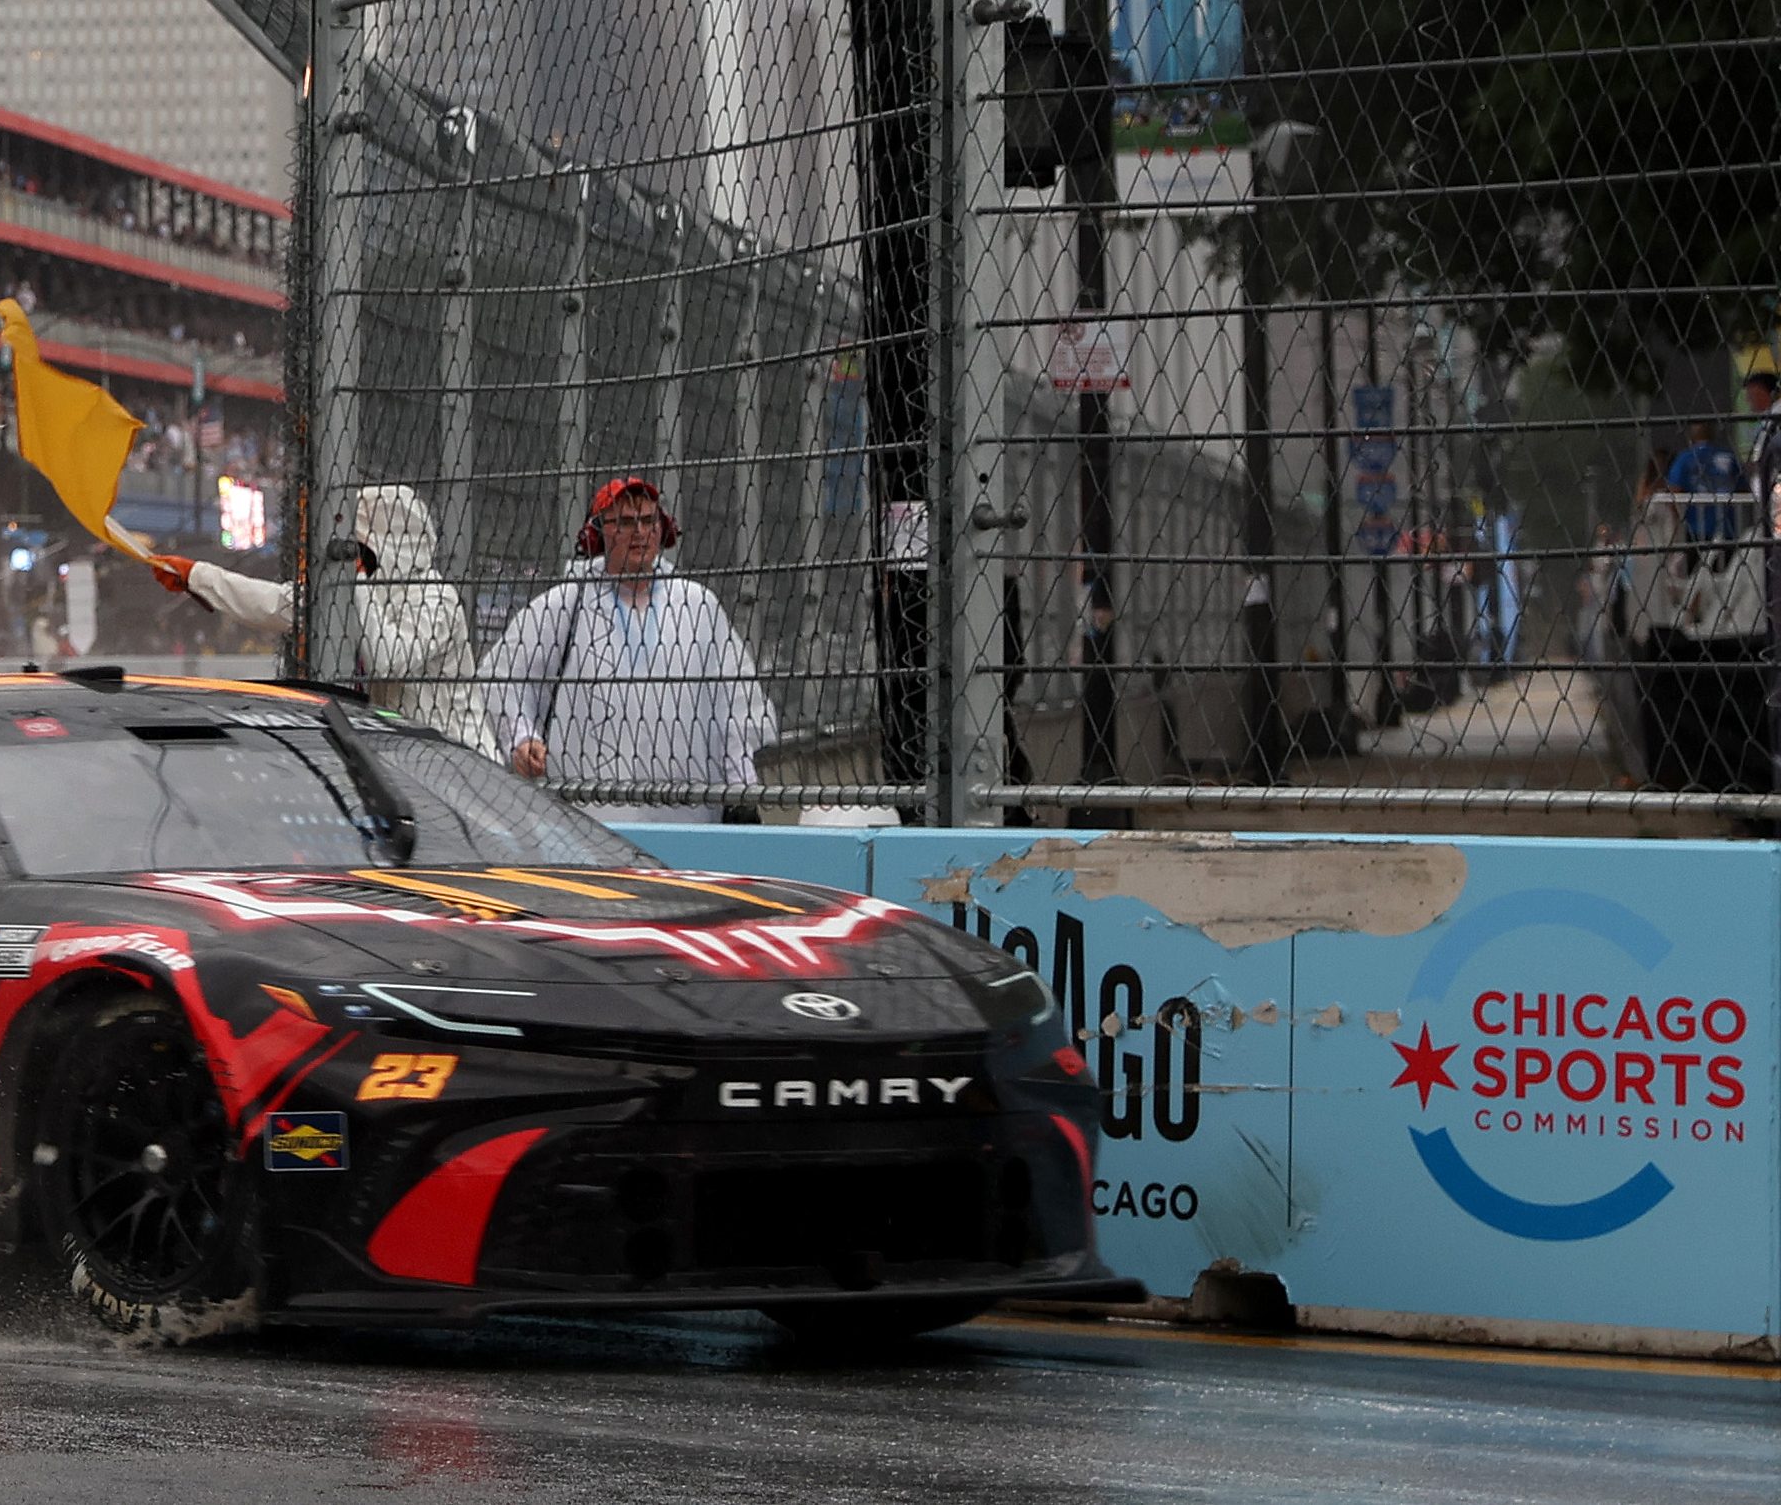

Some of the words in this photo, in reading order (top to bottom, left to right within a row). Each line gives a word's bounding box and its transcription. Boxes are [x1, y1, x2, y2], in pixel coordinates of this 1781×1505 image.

[227, 711, 398, 733] WALLCE
[1472, 990, 1747, 1045] CHICAGO
[355, 1052, 459, 1102] 23
[718, 1076, 974, 1108] CAMRY
[1471, 1045, 1746, 1110] SPORTS
[1474, 1108, 1745, 1143] COMMISSION
